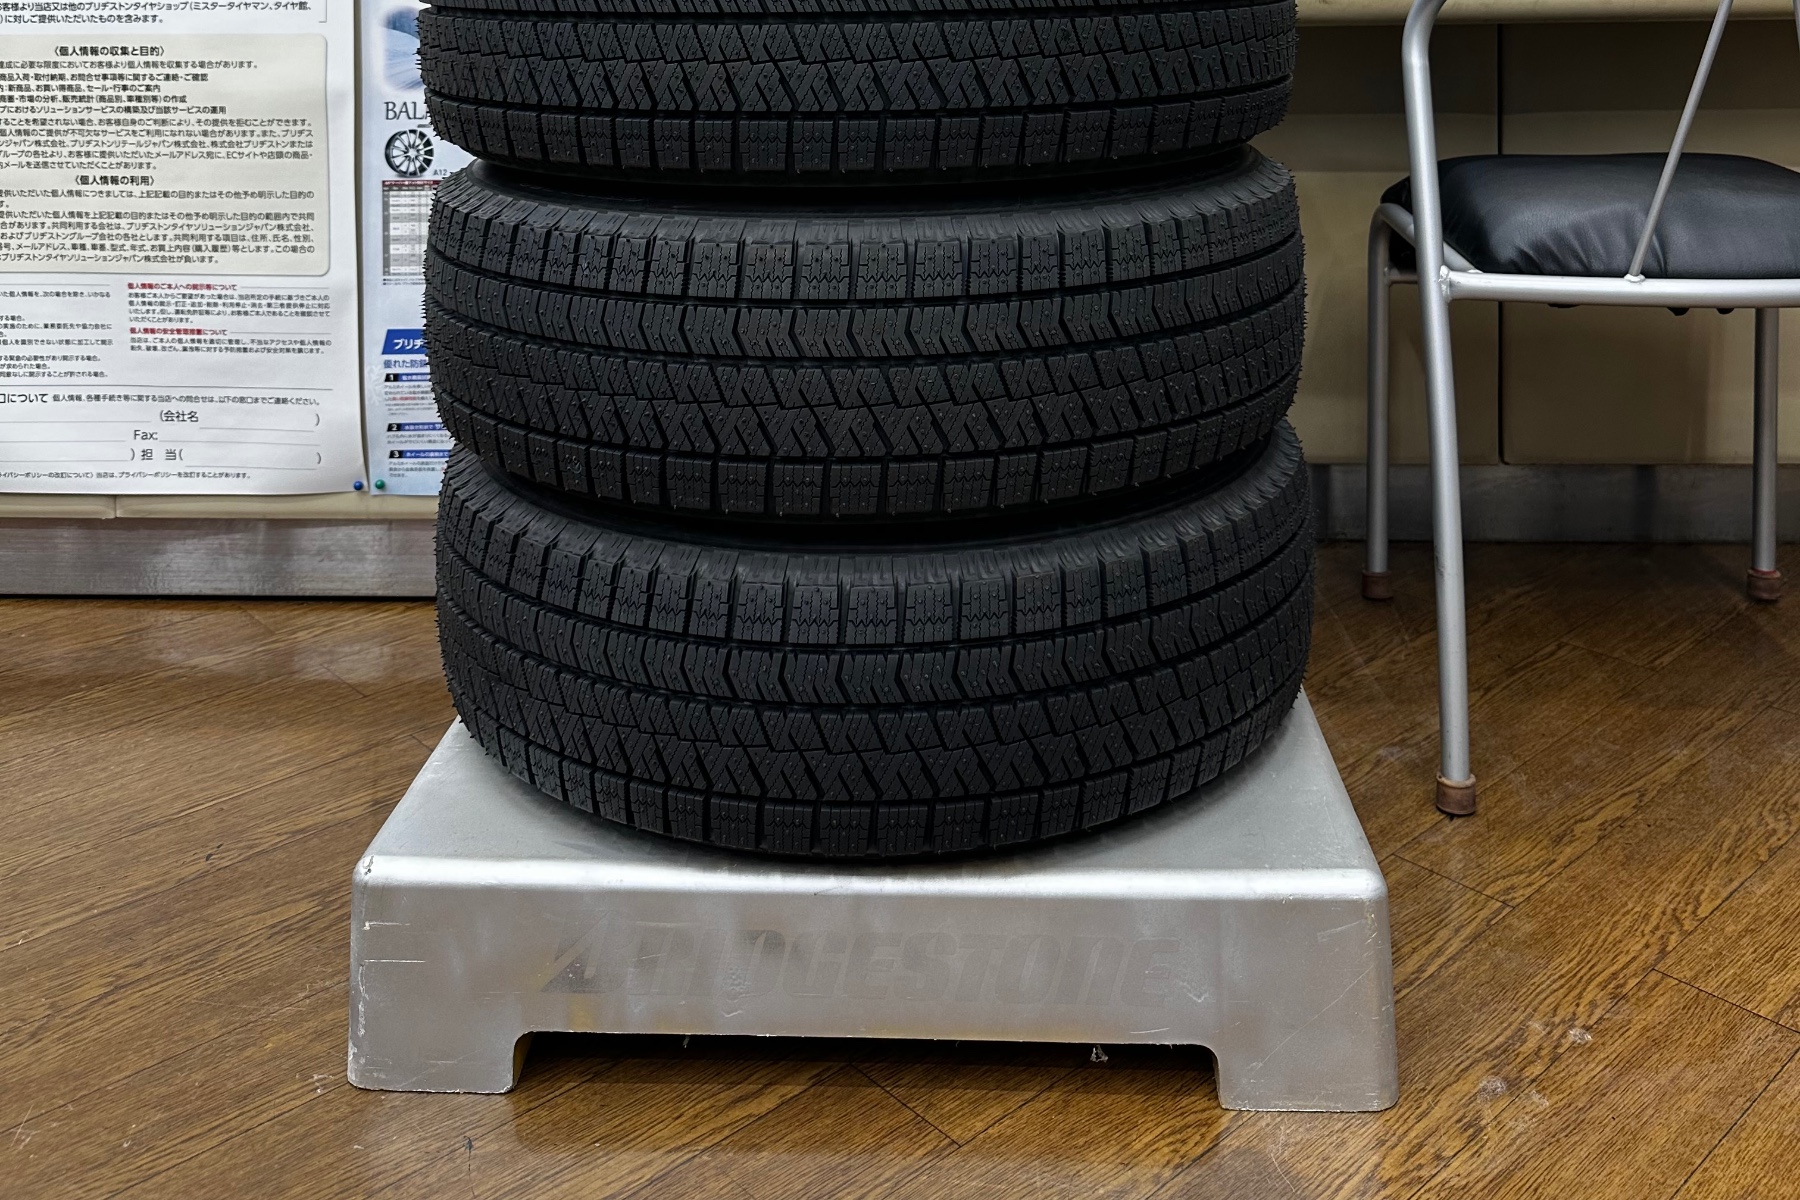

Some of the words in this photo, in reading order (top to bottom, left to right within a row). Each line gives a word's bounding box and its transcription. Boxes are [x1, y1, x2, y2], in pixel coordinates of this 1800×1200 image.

[0, 253, 218, 264] ブリヂストンタイヤソリューションジャパン株式会社が負います。
[134, 430, 158, 440] Fax:
[393, 450, 399, 458] 3
